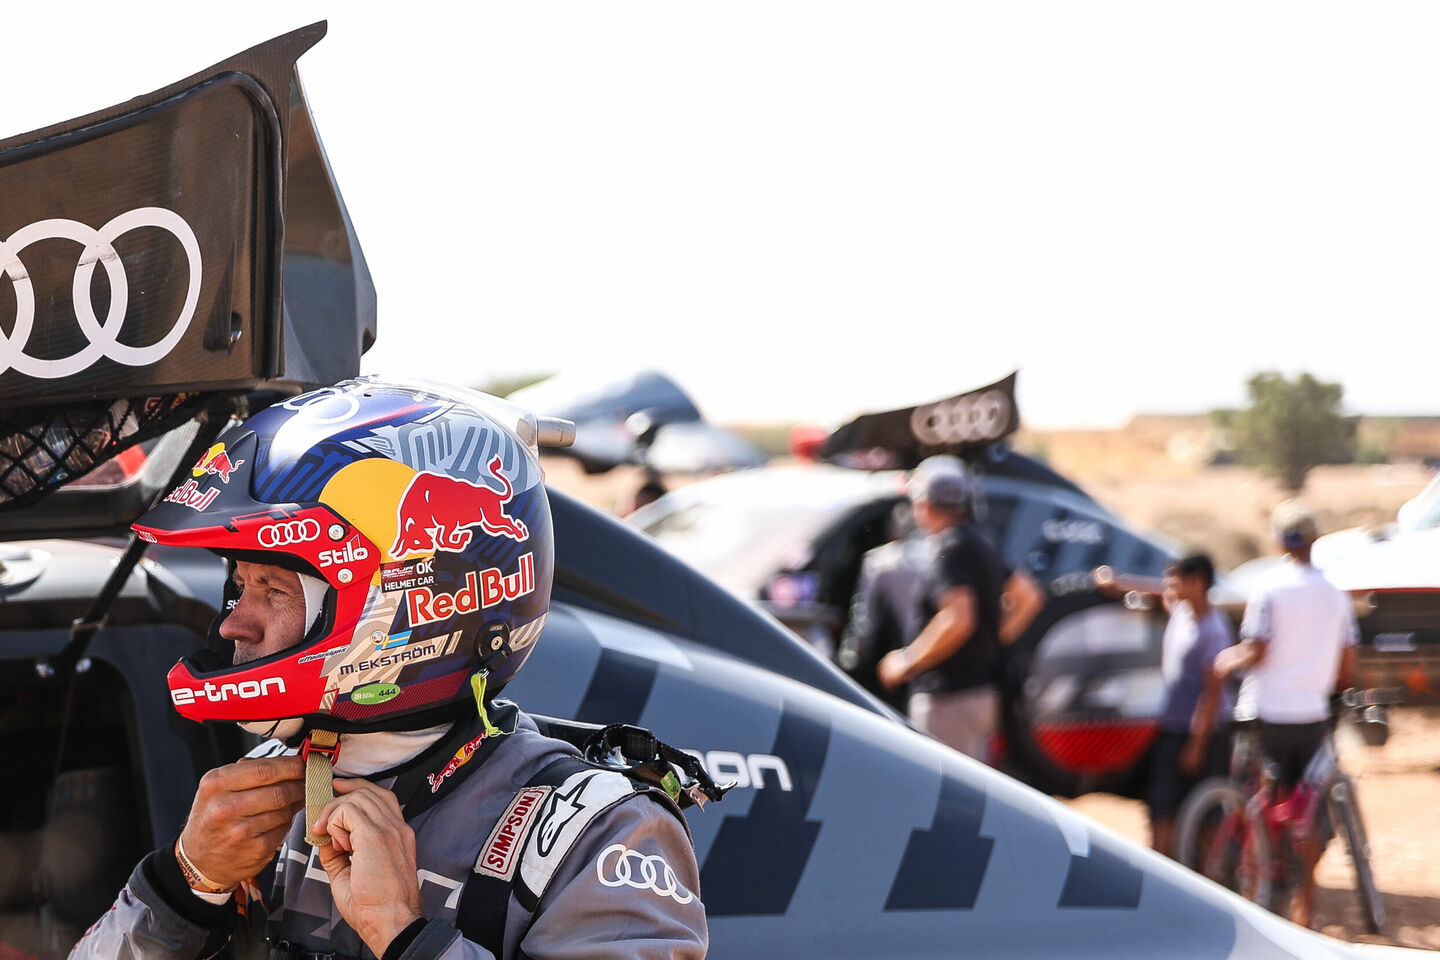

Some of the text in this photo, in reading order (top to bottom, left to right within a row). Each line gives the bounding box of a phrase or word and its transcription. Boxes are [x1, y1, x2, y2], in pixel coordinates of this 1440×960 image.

[416, 560, 434, 575] OK
[384, 575, 435, 591] HELMET CAR
[170, 677, 287, 706] e-tron
[378, 688, 397, 697] 444
[487, 795, 536, 869] SIMPSON
